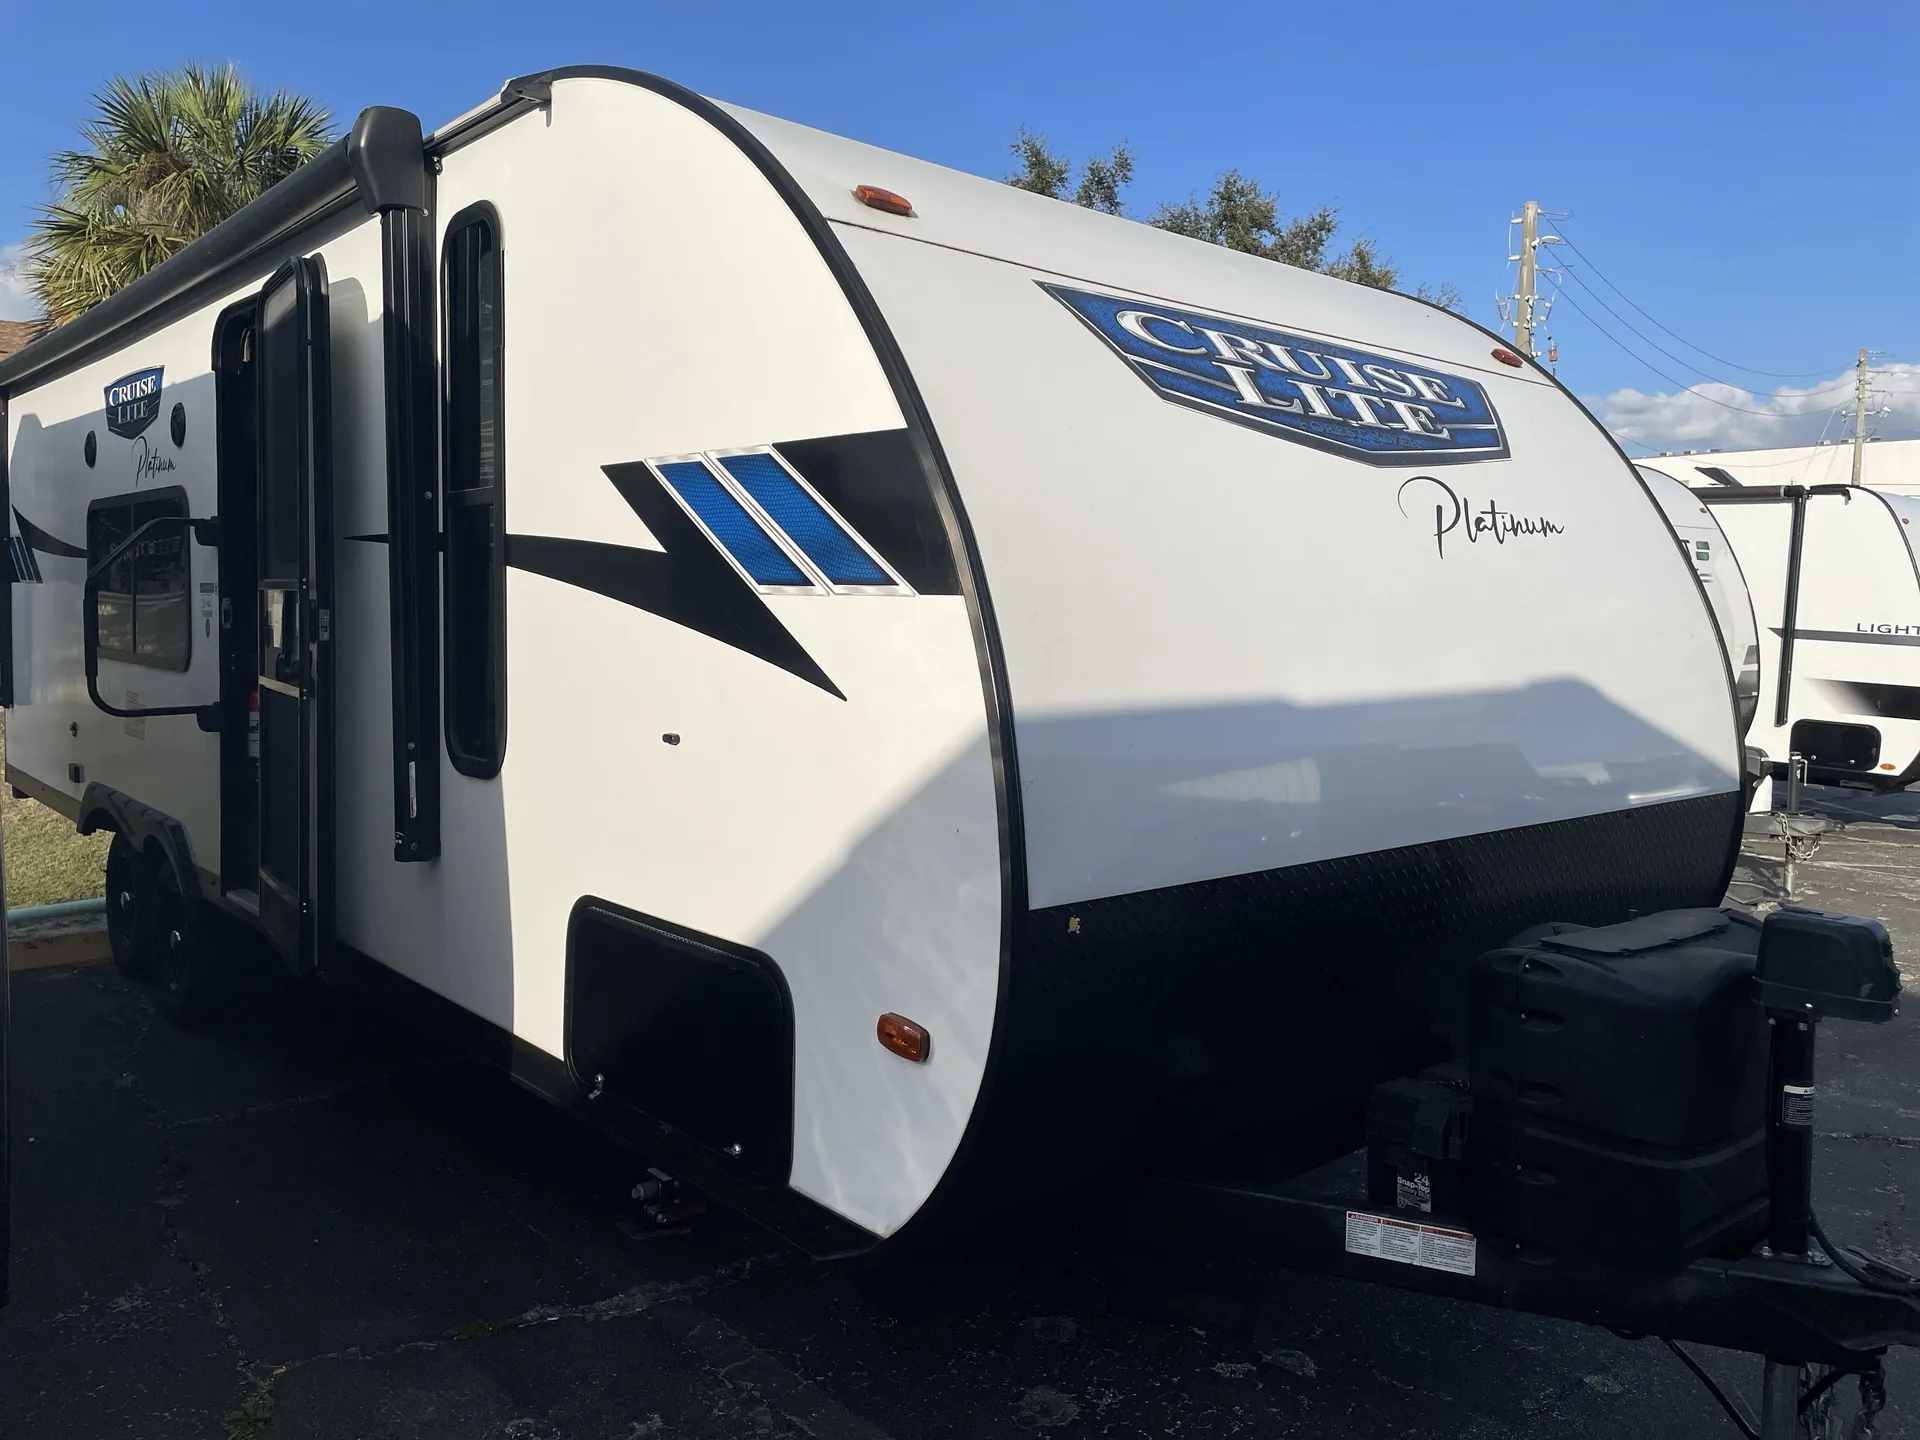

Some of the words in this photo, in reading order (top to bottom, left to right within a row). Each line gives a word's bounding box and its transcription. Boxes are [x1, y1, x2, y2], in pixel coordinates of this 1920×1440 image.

[1116, 310, 1466, 409] CRUISE
[108, 375, 157, 408] CRUISE
[1212, 361, 1453, 440] LITE
[117, 400, 149, 425] LITE
[131, 436, 177, 489] Platinum
[1397, 476, 1565, 560] Platinum
[1856, 622, 1920, 636] LIGHT
[1397, 1176, 1430, 1194] Snap-Top
[1413, 1172, 1430, 1187] 24
